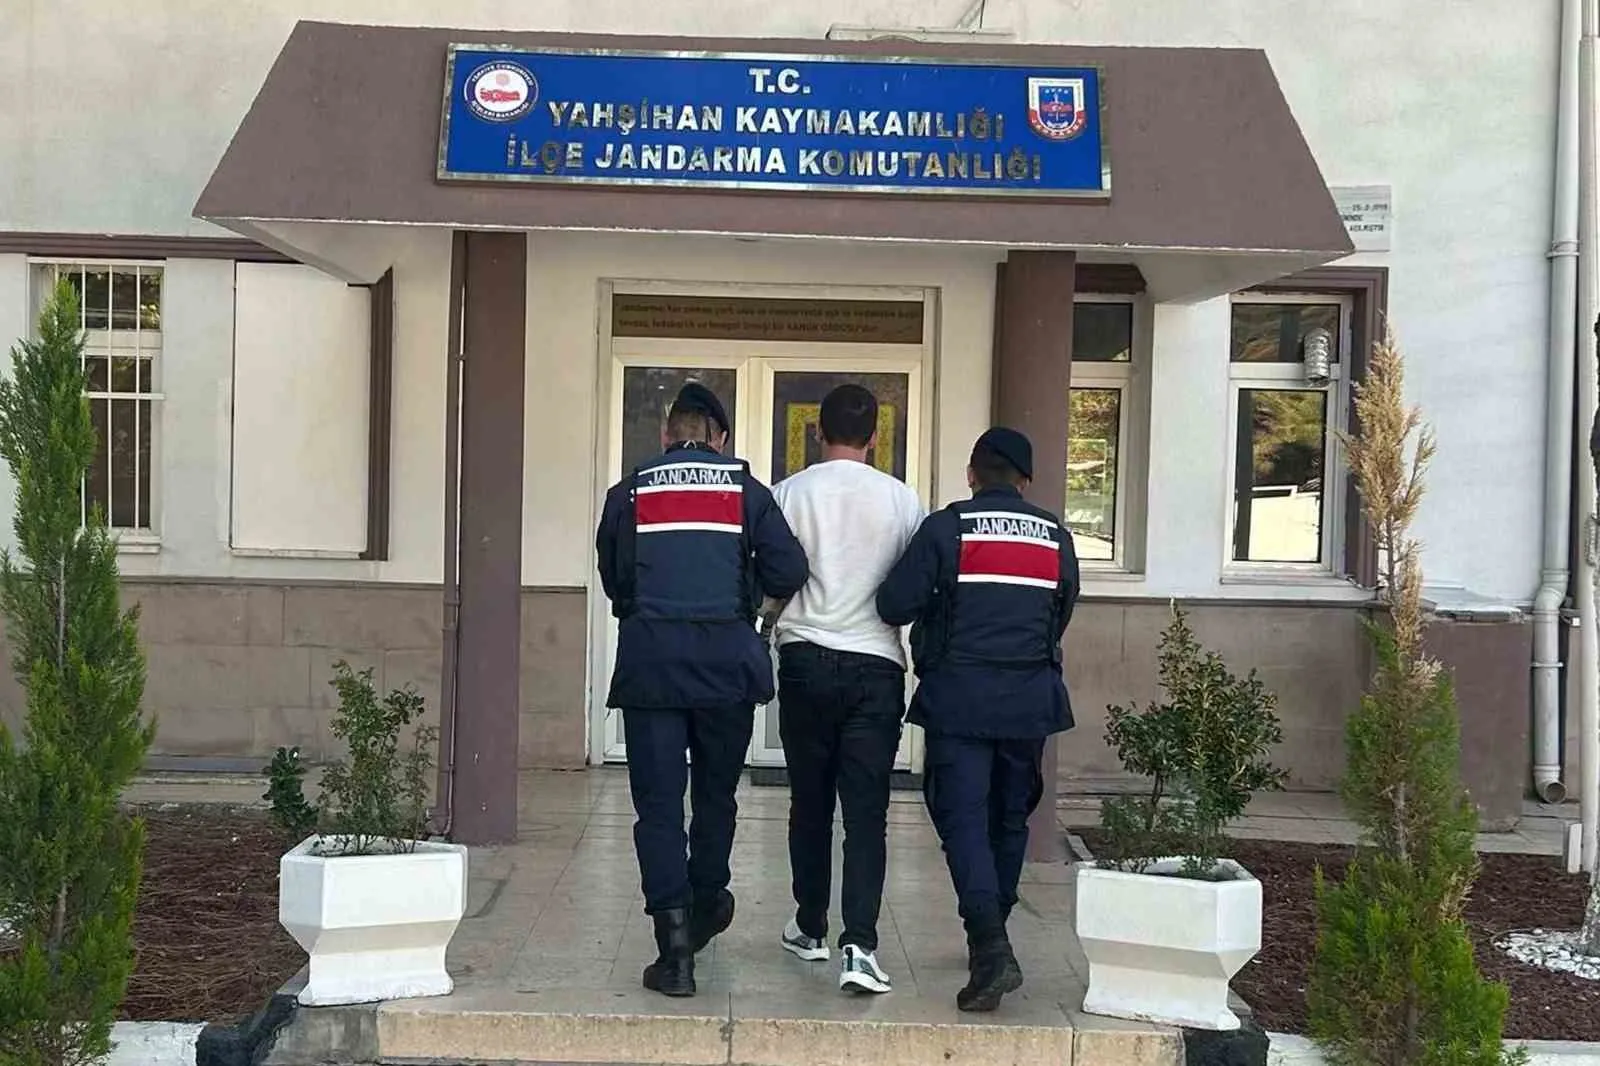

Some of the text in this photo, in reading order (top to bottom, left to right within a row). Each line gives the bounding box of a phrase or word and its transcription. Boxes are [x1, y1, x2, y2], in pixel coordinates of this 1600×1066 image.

[749, 68, 811, 95] T.C.
[548, 98, 723, 136] YAHŞİHAN
[736, 105, 1004, 140] KAYMAKAMLIĞI
[507, 133, 1041, 180] İLÇE JANDARMA KOMUTANLIĞI
[648, 468, 733, 486] JANDARMA
[972, 518, 1052, 540] JANDARMA
